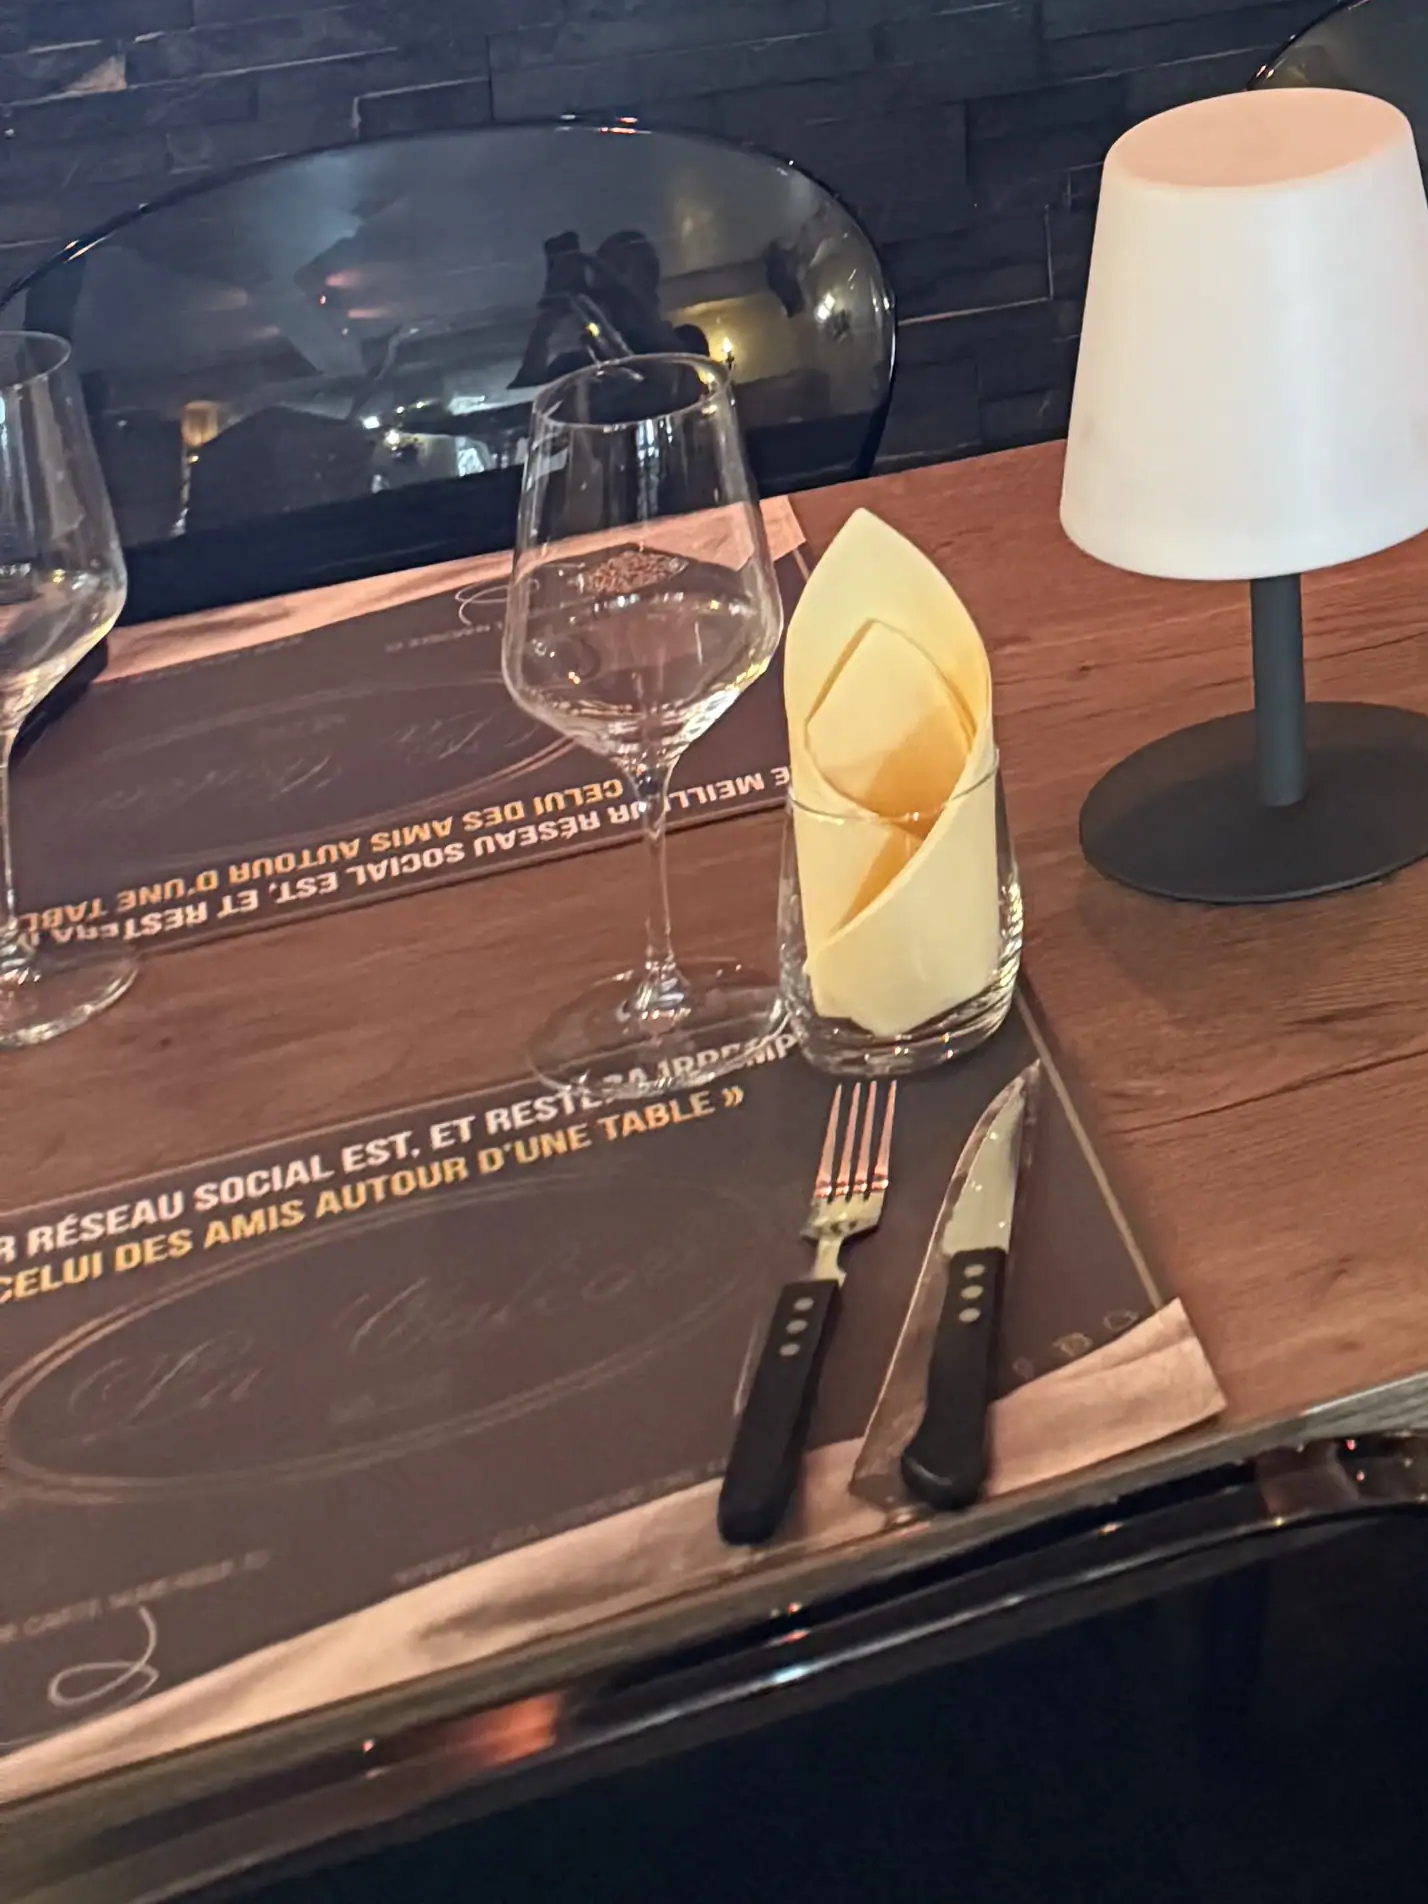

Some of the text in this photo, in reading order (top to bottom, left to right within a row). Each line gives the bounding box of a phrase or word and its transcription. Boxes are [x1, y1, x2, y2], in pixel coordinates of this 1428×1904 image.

[463, 800, 525, 832] DES
[533, 778, 624, 817] CELUI
[371, 815, 453, 853] AMIS
[474, 809, 601, 857] RÉSEAU
[229, 837, 361, 884] AUTOUR
[346, 842, 465, 888] SOCIAL
[116, 872, 219, 913] D'UNE
[216, 889, 260, 917] ET
[269, 871, 339, 905] EST,
[26, 1189, 186, 1258] RÉSEAU
[193, 1154, 336, 1212] SOCIAL
[341, 1130, 421, 1174] EST,
[430, 1114, 476, 1151] ET
[113, 1227, 194, 1274] DES
[203, 1199, 306, 1251] AMIS
[314, 1156, 471, 1220] AUTOUR
[478, 1122, 592, 1176] D'UNE
[597, 1087, 717, 1142] TABLE
